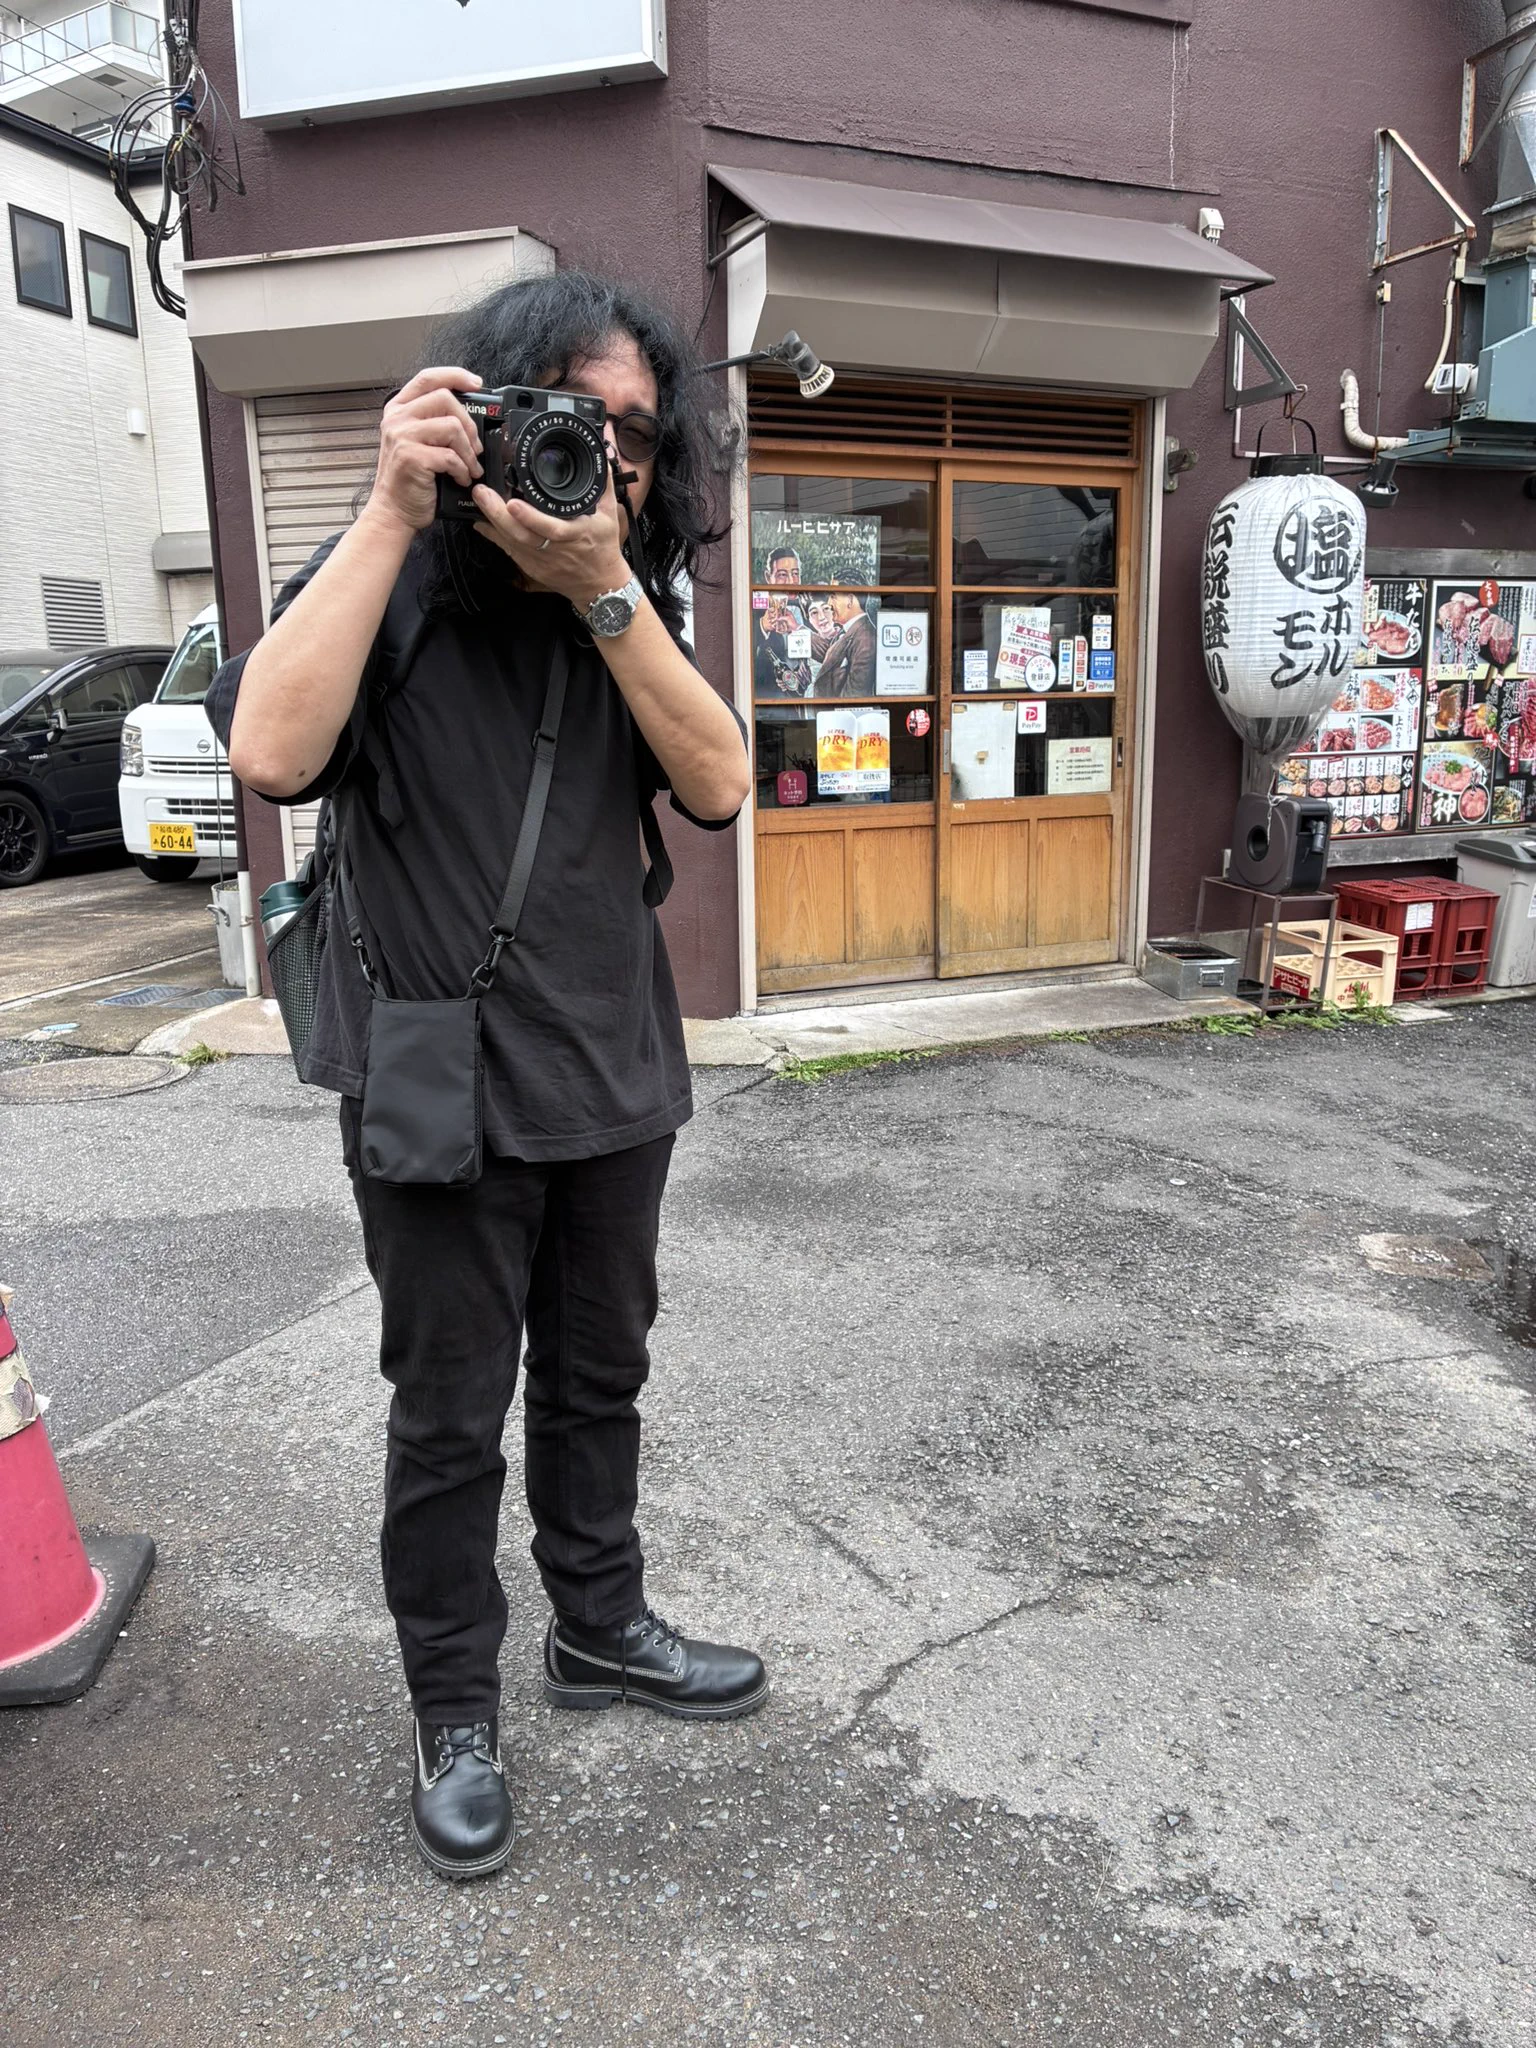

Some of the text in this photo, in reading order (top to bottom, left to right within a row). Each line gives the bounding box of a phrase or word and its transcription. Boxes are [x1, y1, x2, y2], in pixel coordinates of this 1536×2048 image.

[521, 435, 532, 468] NIKKOR
[525, 479, 599, 512] LENS MADE IN JAPAN
[1405, 582, 1423, 649] 牛たん
[1009, 652, 1028, 667] 現金
[822, 735, 849, 746] DRY
[860, 737, 885, 749] DRY
[160, 835, 193, 849] 60-44
[1274, 969, 1309, 989] アサヒビール
